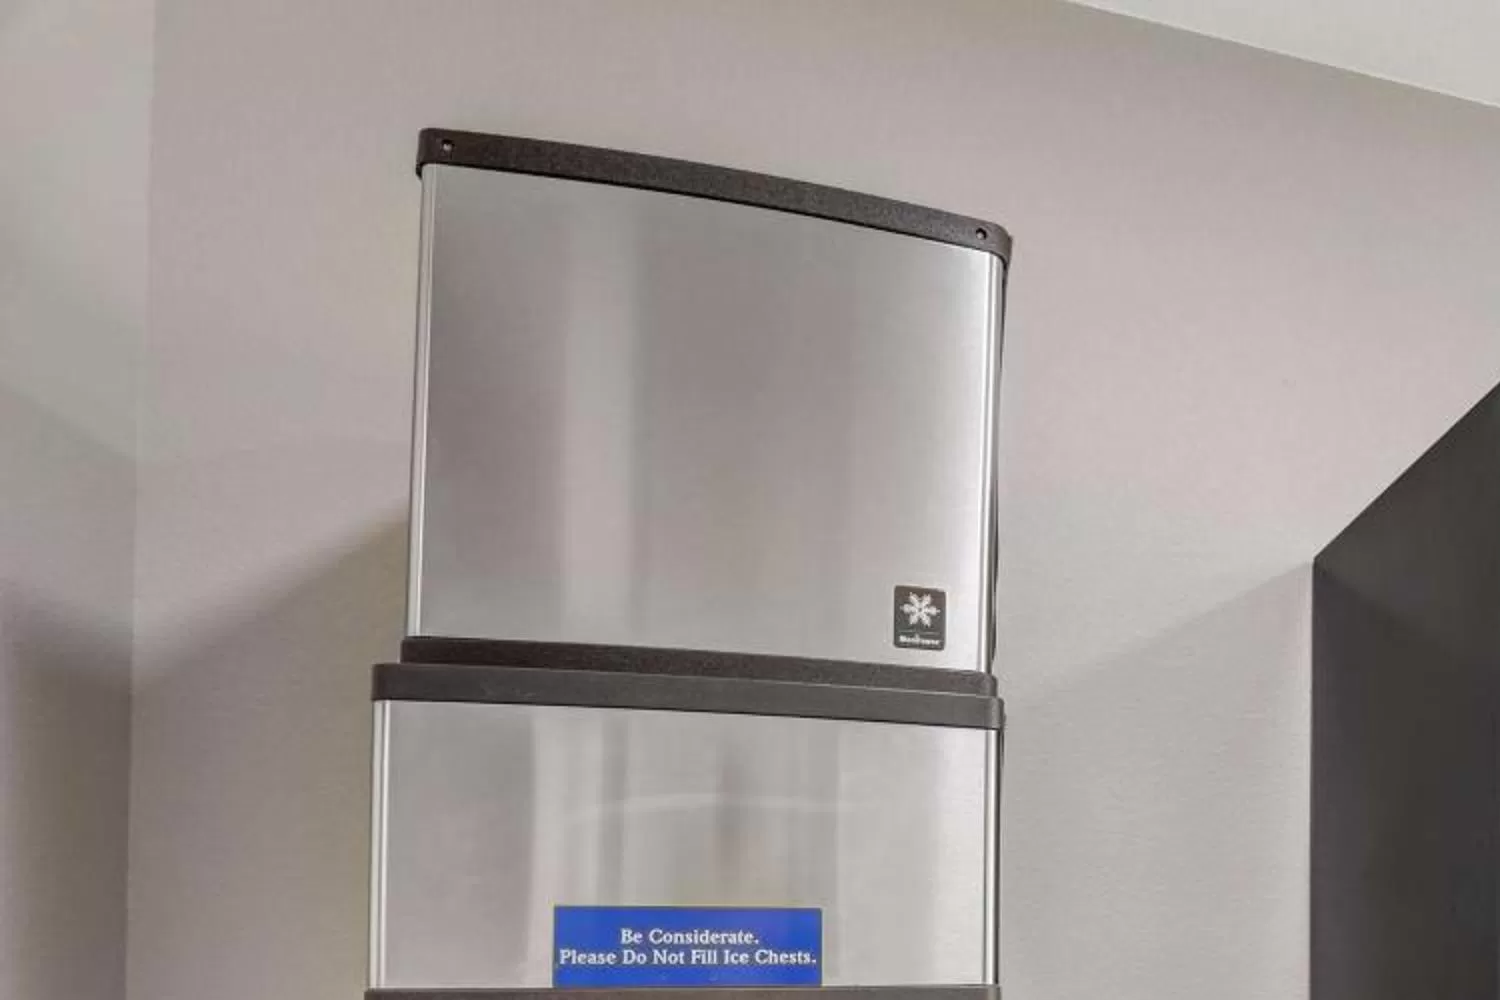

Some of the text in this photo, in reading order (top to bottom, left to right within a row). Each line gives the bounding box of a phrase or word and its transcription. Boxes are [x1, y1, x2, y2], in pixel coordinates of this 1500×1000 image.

[620, 928, 759, 945] Be Considerate.
[559, 949, 817, 965] Please Do Not Fill Ice Chests.
